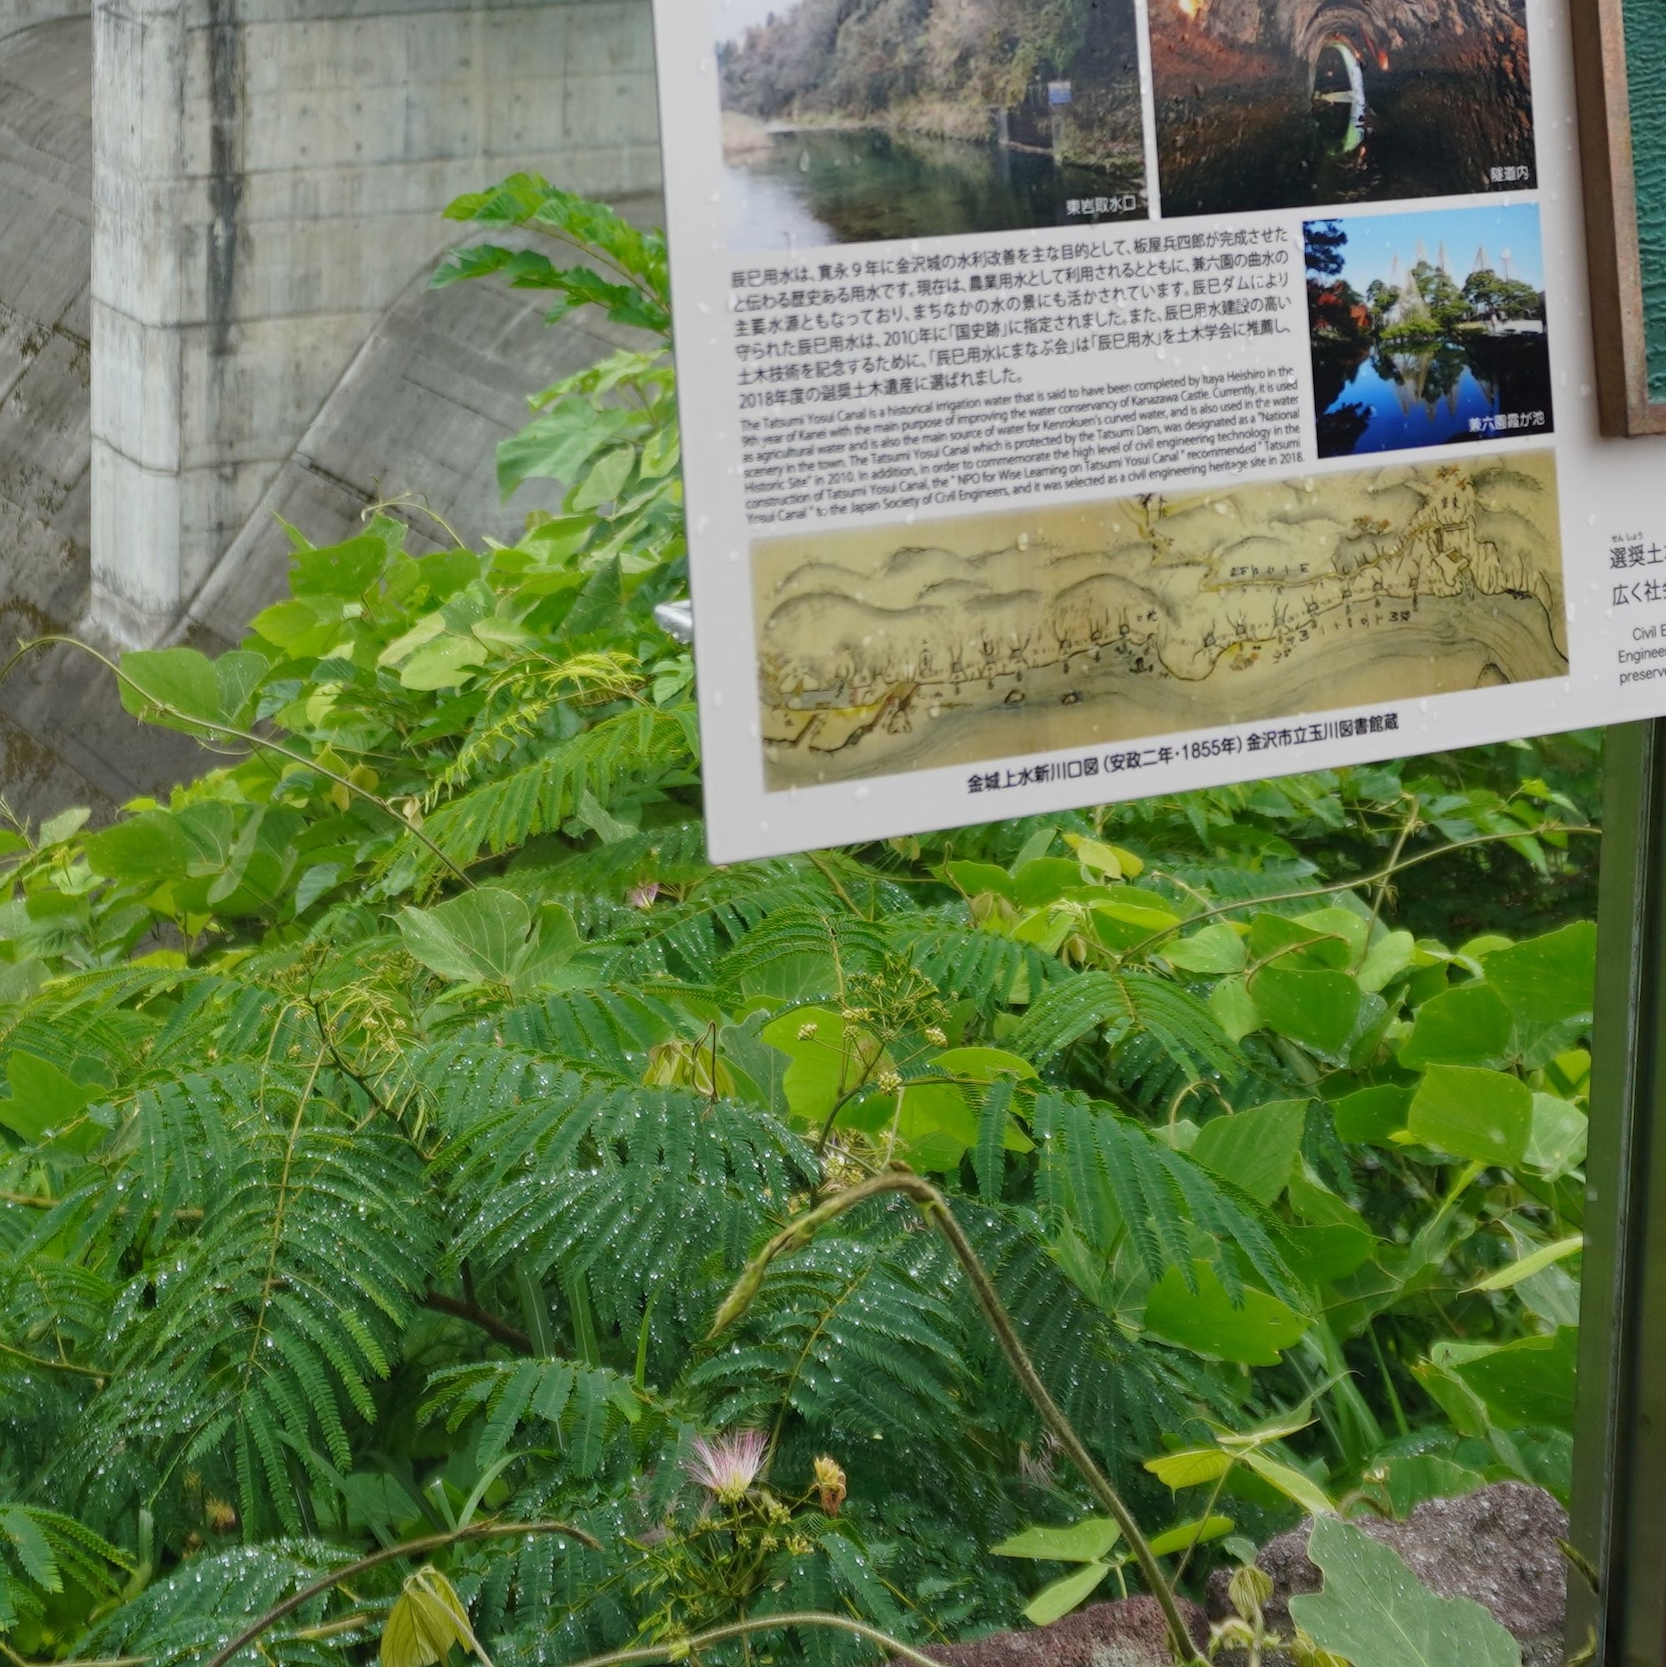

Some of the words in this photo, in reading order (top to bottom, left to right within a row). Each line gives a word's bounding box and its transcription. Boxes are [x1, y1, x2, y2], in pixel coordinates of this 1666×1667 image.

[1066, 193, 1138, 217] 東岩取水口
[740, 419, 761, 431] The
[762, 417, 805, 430] Tatsumi
[806, 412, 836, 425] Yosui
[836, 408, 867, 422] Canal
[868, 408, 878, 419] is
[879, 408, 886, 418] a
[887, 401, 934, 417] historical
[935, 398, 982, 413] irrigation
[983, 395, 1013, 407] water
[1013, 392, 1035, 404] that
[1036, 391, 1046, 402] is
[1046, 387, 1067, 401] said
[1068, 388, 1080, 399] to
[1080, 386, 1106, 397] have
[1106, 383, 1132, 395] been
[1133, 375, 1187, 392] completed
[1187, 375, 1201, 388] by
[1201, 374, 1225, 386] Itaya
[1226, 369, 1266, 382] Heishiro
[1267, 367, 1277, 378] in
[1277, 365, 1294, 377] the
[1064, 473, 1106, 489] selected
[1107, 474, 1118, 485] as
[1119, 473, 1126, 483] a
[1127, 468, 1147, 482] civil
[1148, 464, 1207, 481] engineering
[1208, 460, 1249, 472] heritage
[1249, 456, 1267, 468] site
[1268, 455, 1278, 466] in
[1279, 451, 1304, 465] 2018.
[1632, 625, 1657, 642] Civil
[968, 757, 1099, 794] 金城上水新川口図
[1247, 712, 1399, 752] 金沢市立玉川図書館蔵
